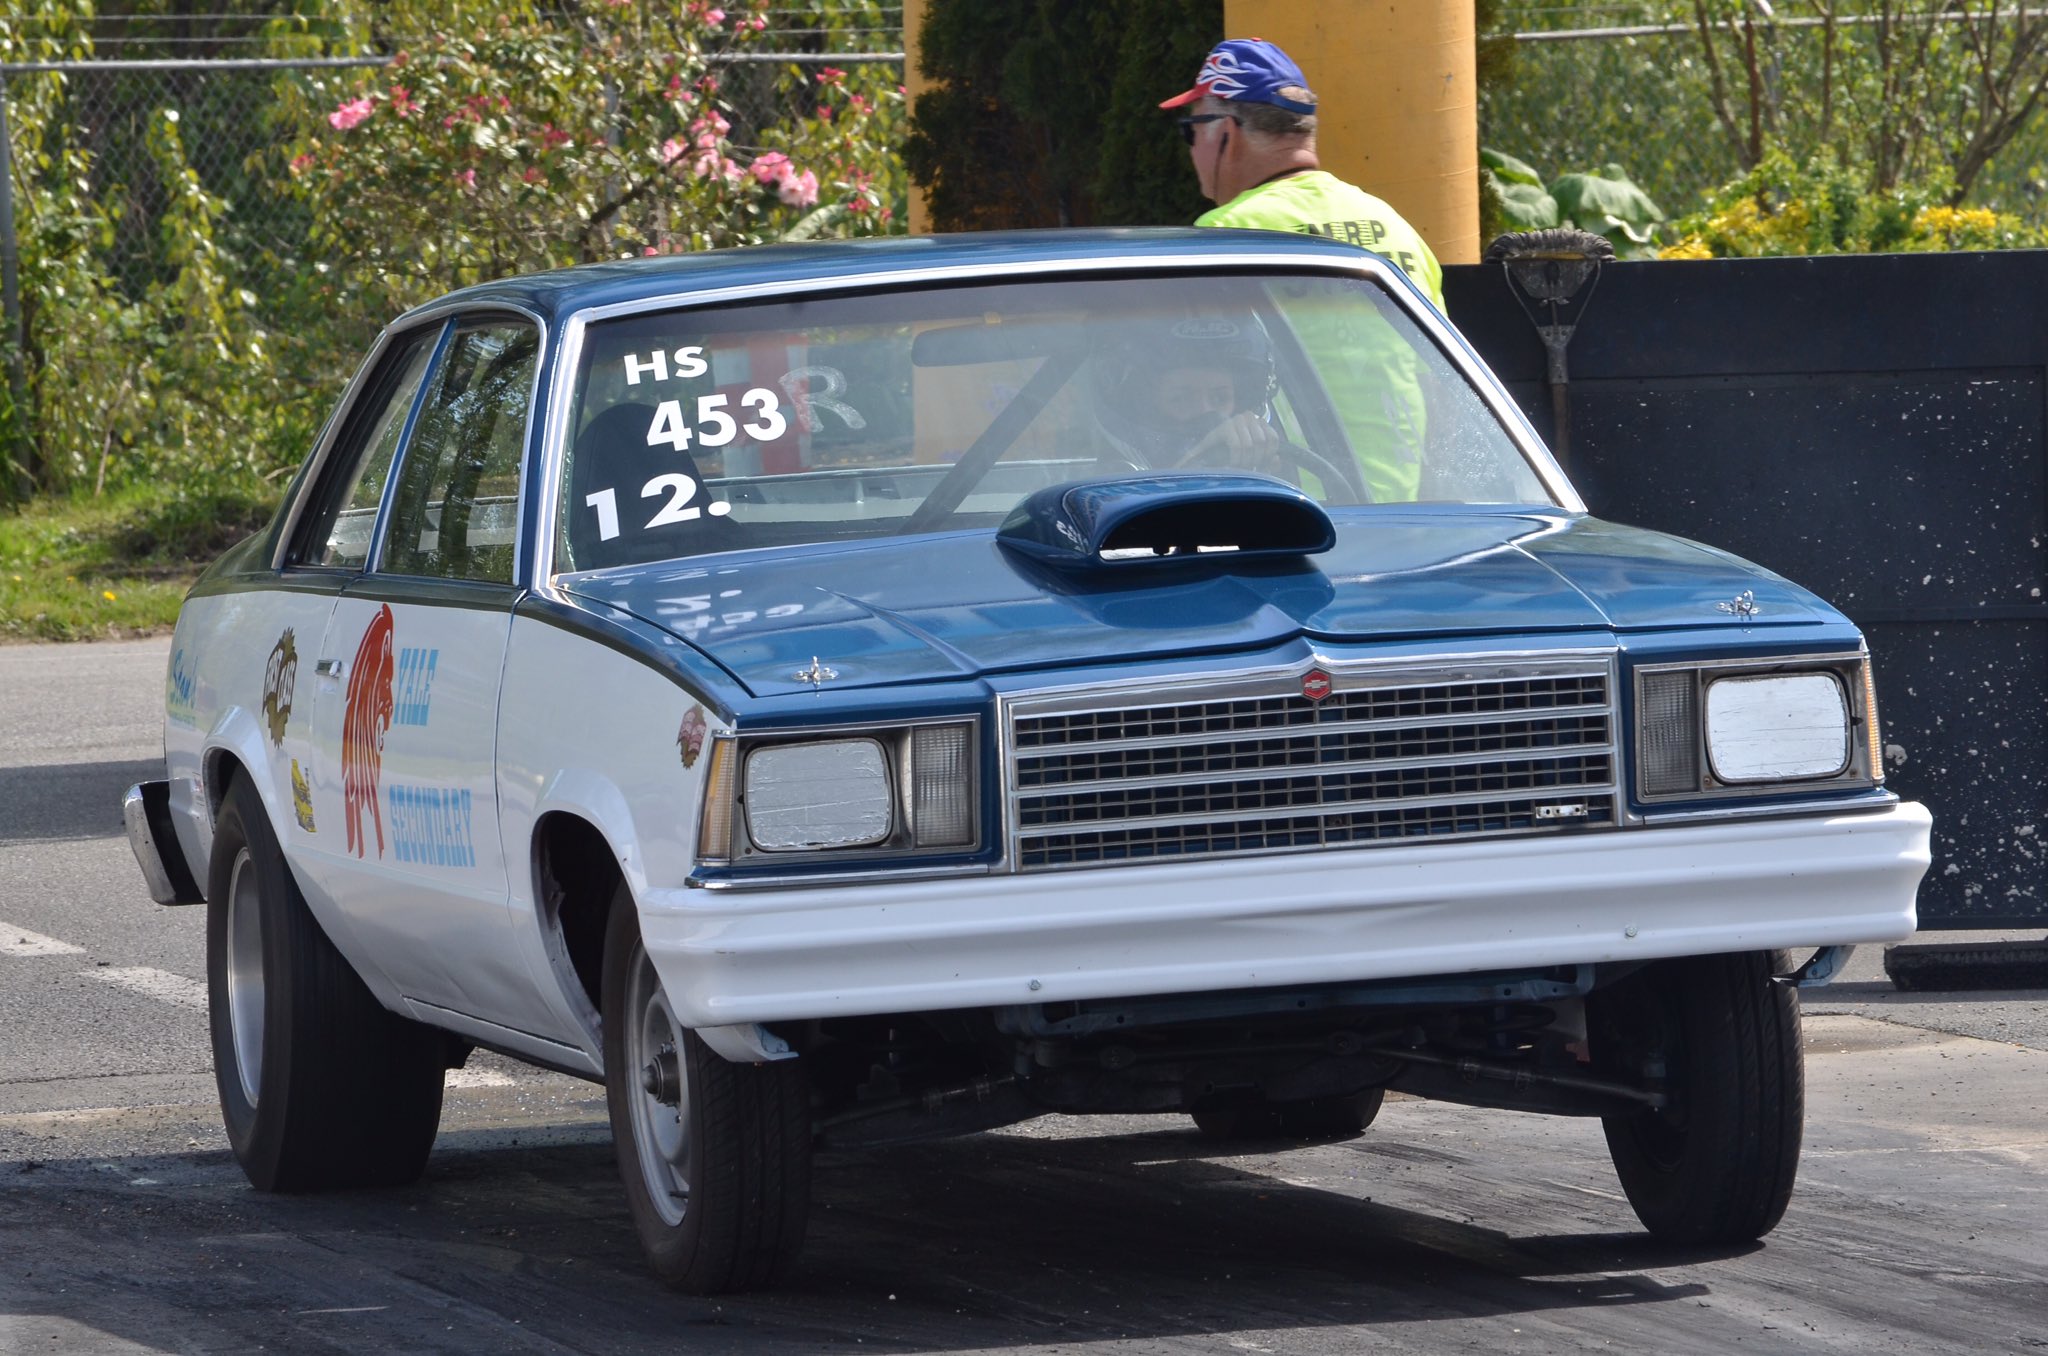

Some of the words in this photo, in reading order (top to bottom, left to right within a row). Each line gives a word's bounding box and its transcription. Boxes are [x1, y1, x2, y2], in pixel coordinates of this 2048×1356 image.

[623, 346, 708, 386] HS
[777, 365, 867, 433] R
[646, 387, 787, 451] 453
[393, 648, 439, 727] YALE
[389, 783, 476, 868] SECONDARY
